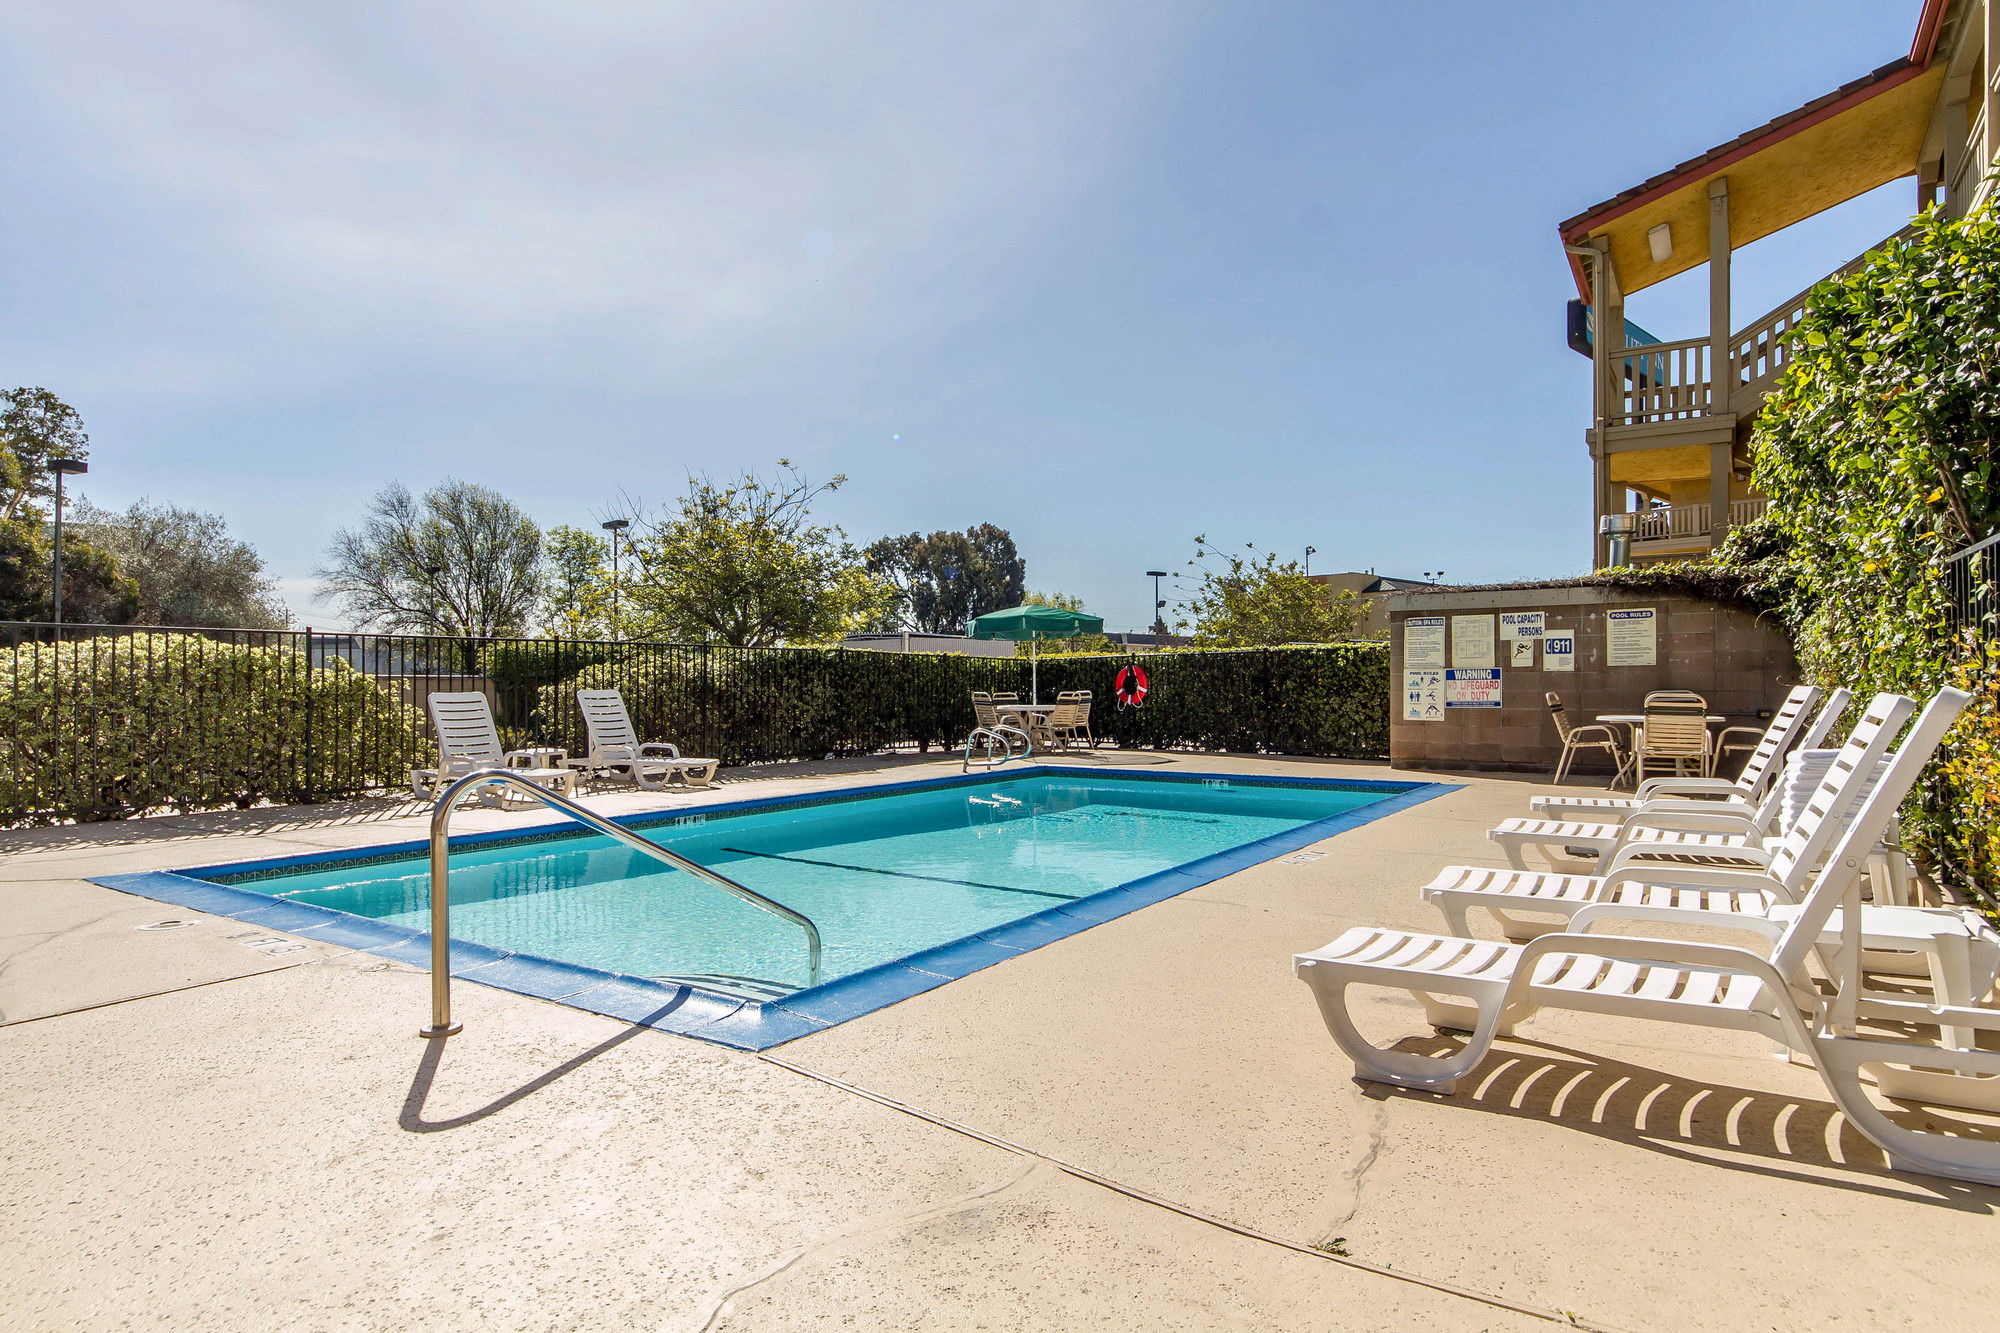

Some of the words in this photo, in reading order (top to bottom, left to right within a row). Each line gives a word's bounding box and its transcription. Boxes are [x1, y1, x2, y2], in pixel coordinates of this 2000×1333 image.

[1502, 615, 1516, 624] POOL
[1518, 614, 1542, 624] CAPACITY
[1518, 626, 1542, 636] PERSONS
[1553, 640, 1570, 652] 911
[1454, 669, 1492, 680] WARNING
[1447, 681, 1457, 690] NO
[1460, 680, 1499, 690] LIFEGUARD
[1456, 691, 1467, 700] ON
[1470, 691, 1489, 700] DUTY
